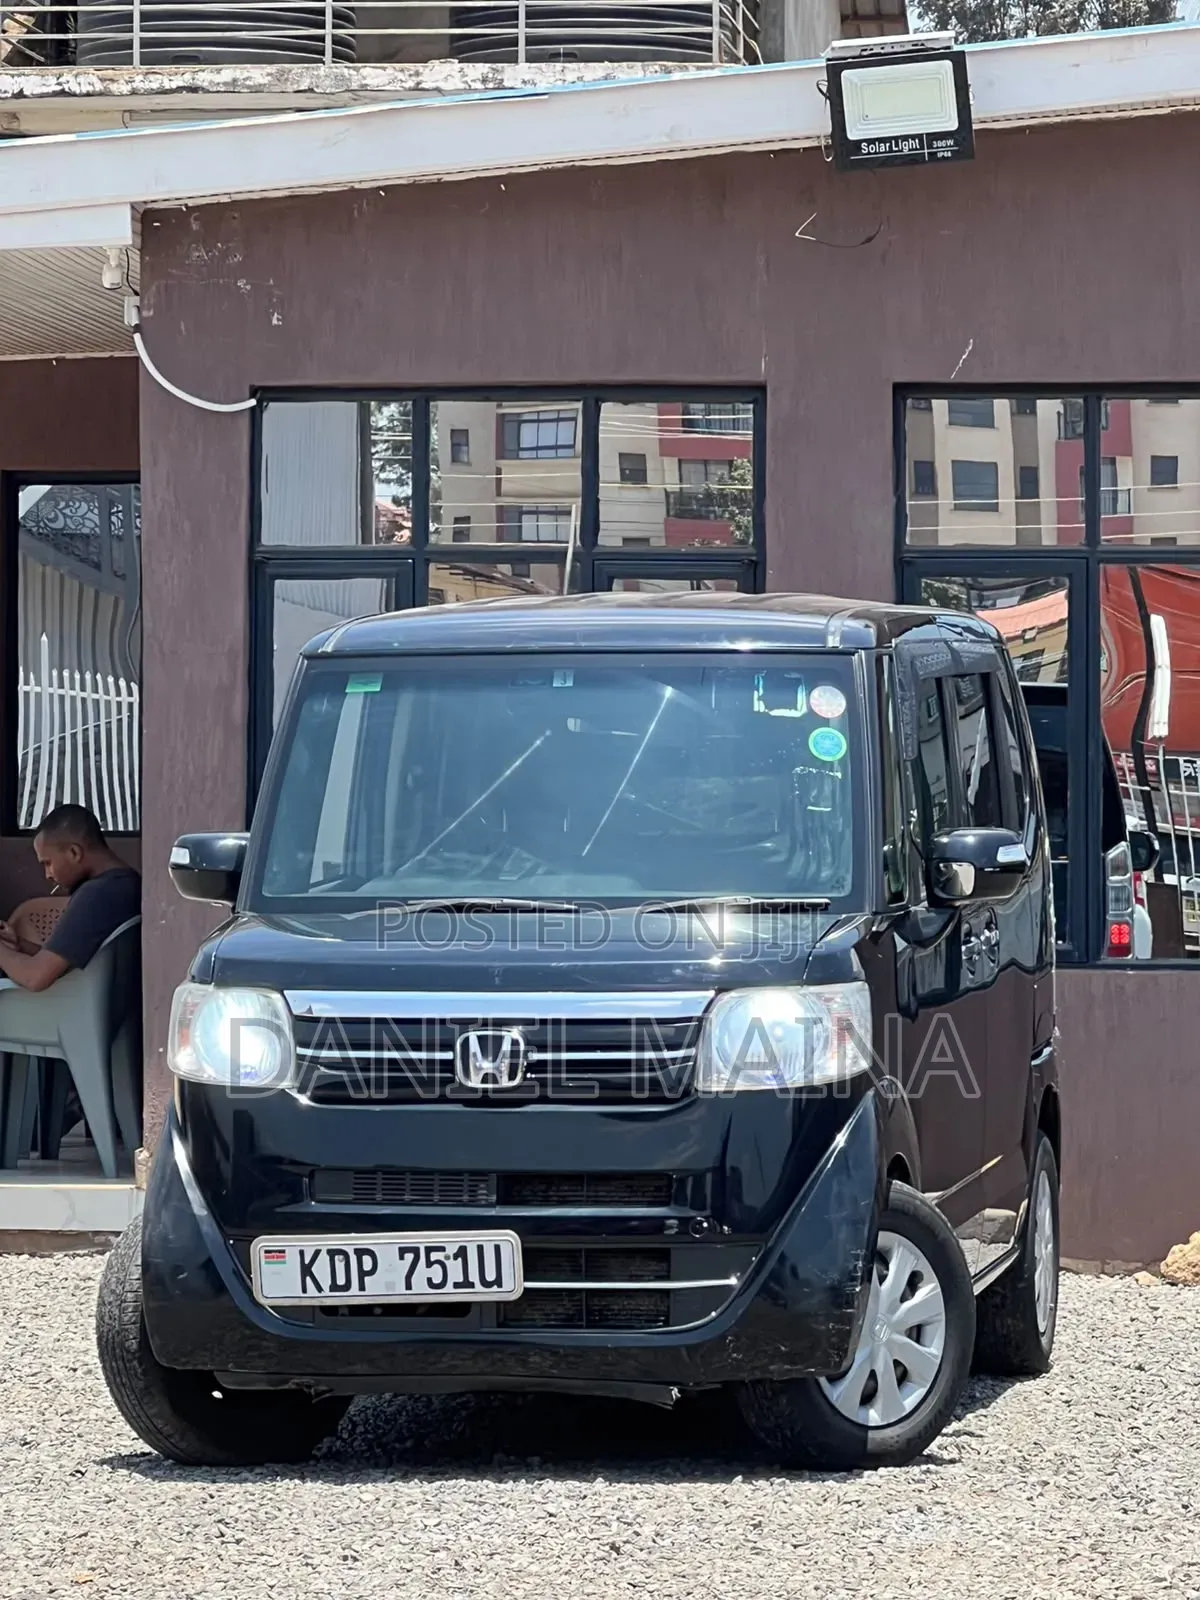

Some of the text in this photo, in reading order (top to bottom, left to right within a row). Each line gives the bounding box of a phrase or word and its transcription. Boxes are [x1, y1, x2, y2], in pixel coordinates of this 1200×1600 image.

[861, 138, 920, 154] Solar Light
[932, 139, 954, 148] 300W
[298, 1244, 503, 1294] KDP 751U
